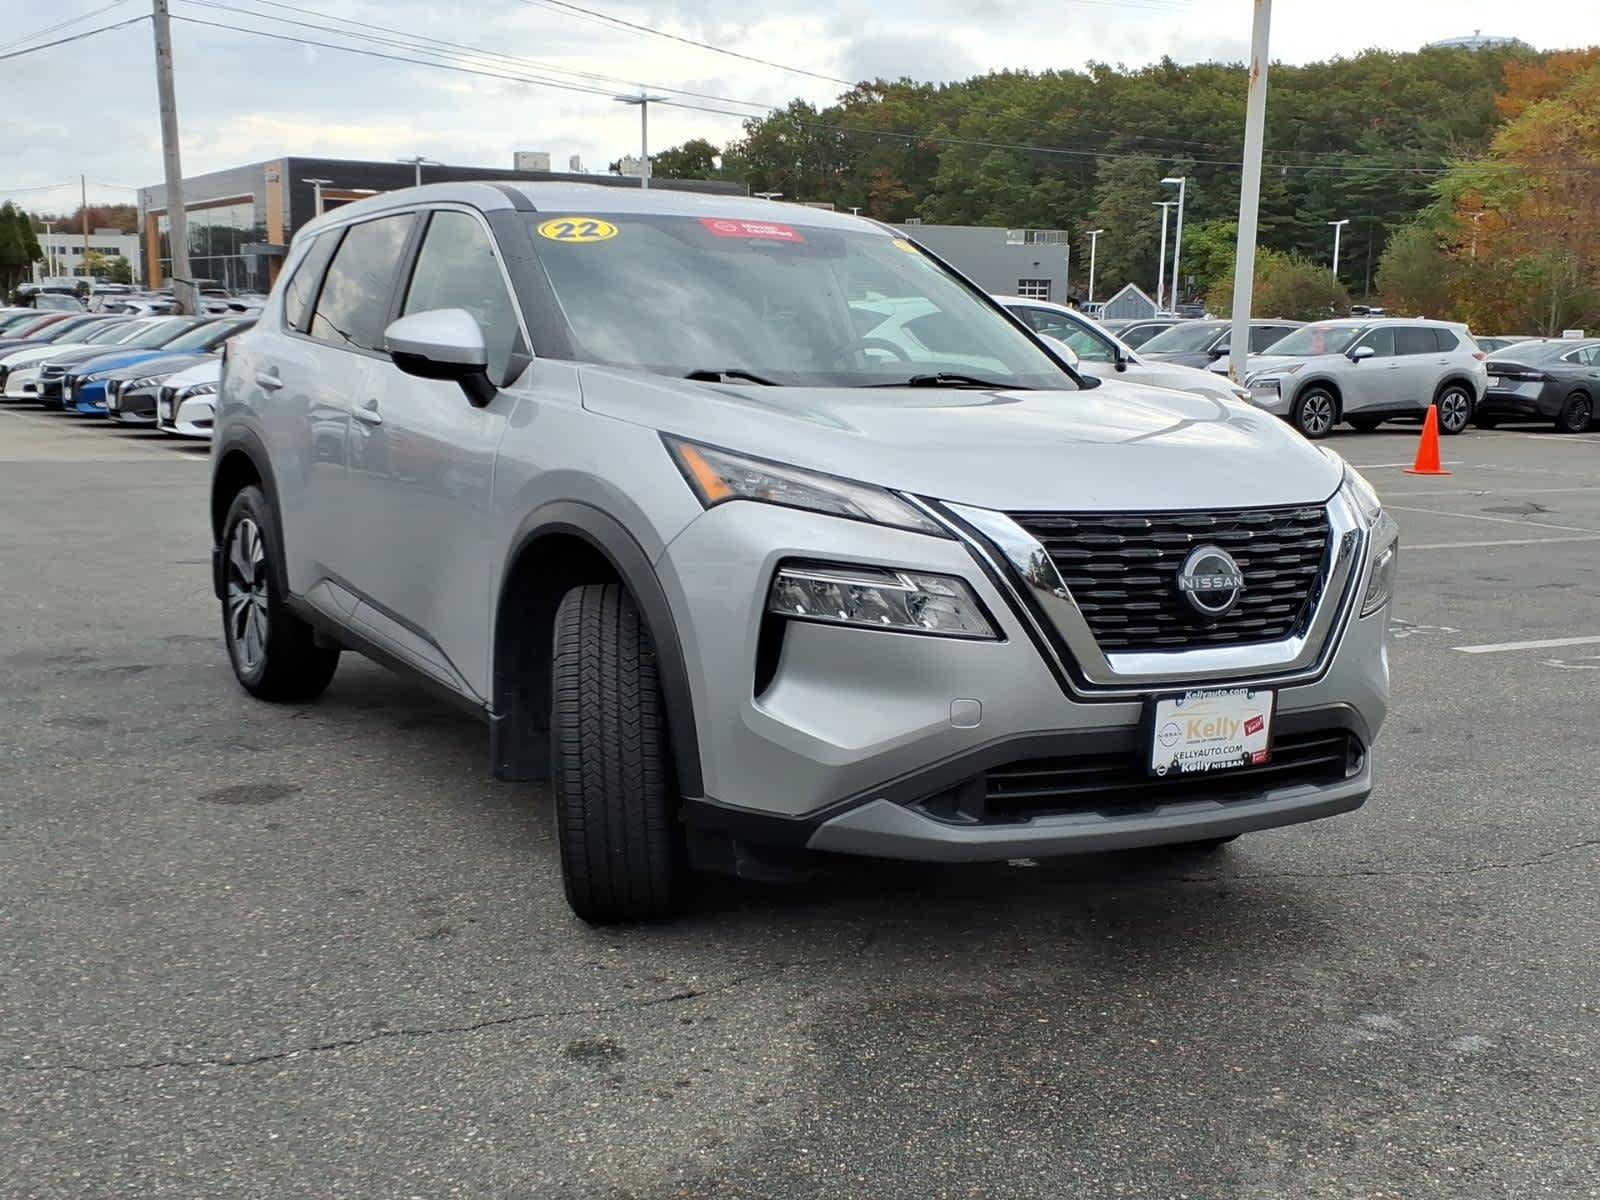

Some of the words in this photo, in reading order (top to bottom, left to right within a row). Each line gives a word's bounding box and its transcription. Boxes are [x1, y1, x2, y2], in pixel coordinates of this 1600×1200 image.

[554, 222, 600, 238] 22
[1182, 576, 1242, 588] NISSAN
[1185, 688, 1248, 700] Kellyauto.com
[1186, 716, 1240, 741] Kelly
[1173, 745, 1243, 761] KELLYAUTO.COM
[1181, 760, 1211, 773] Kelly
[1211, 759, 1245, 769] NISSAN
